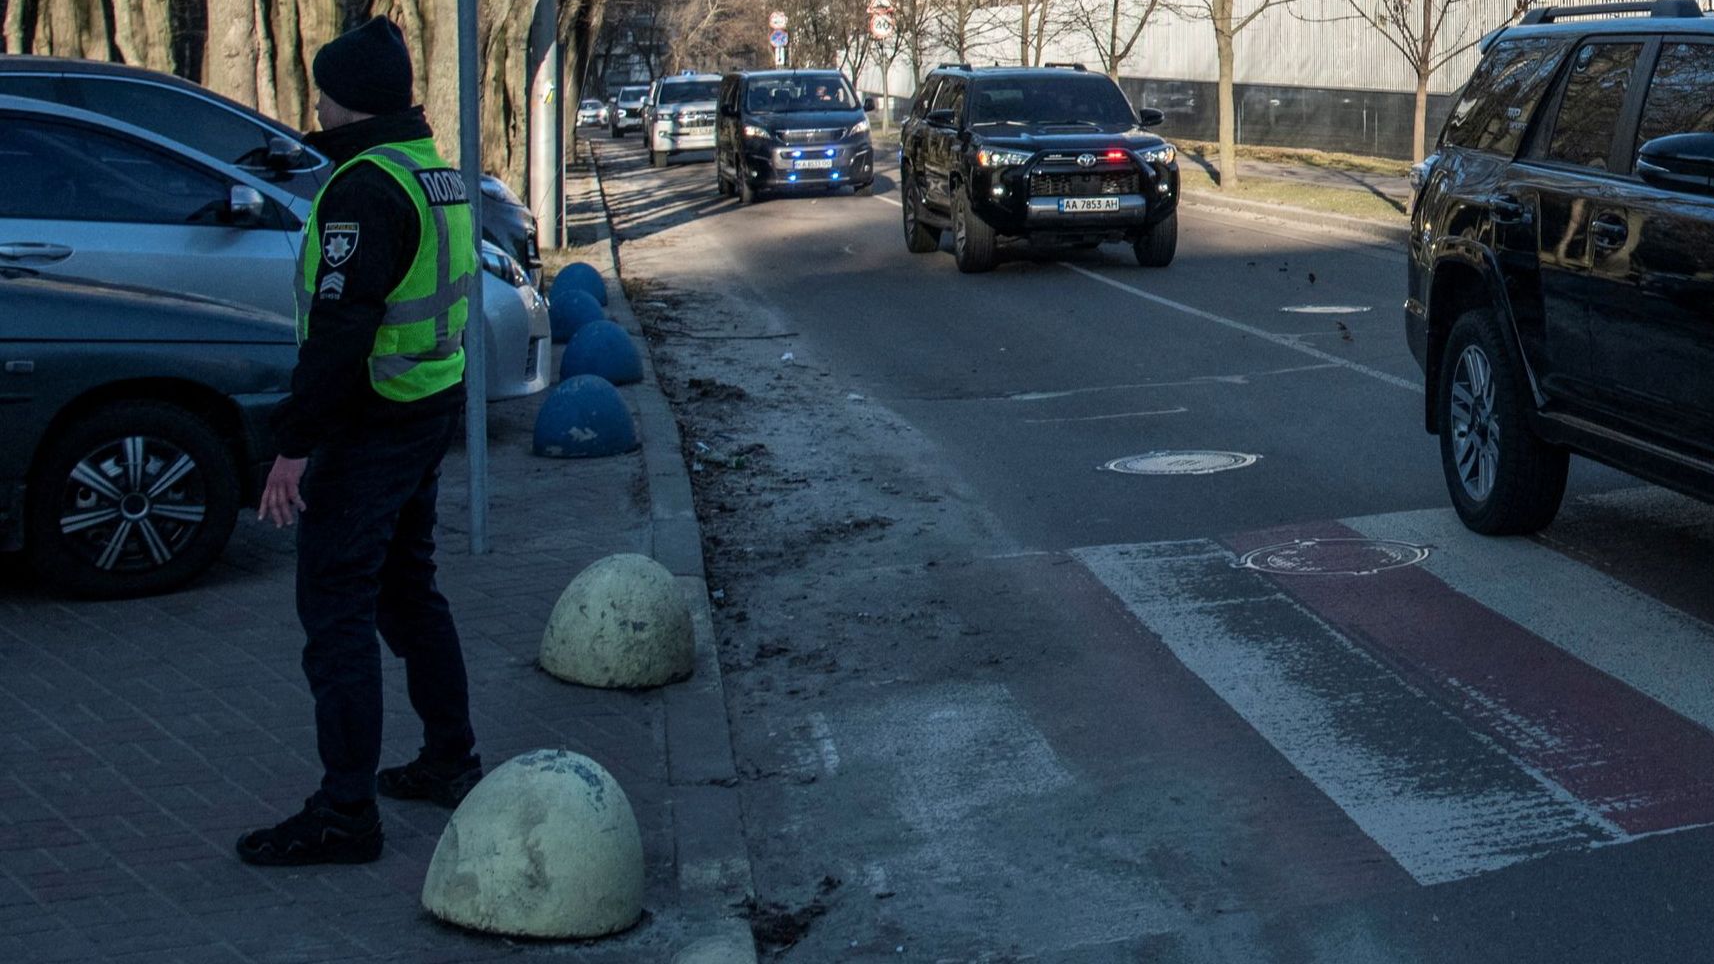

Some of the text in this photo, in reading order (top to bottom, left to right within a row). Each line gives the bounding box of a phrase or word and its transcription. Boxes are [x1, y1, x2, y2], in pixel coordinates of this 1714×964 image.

[1065, 200, 1078, 209] AA
[1081, 200, 1102, 209] 7853
[1105, 199, 1118, 209] AH
